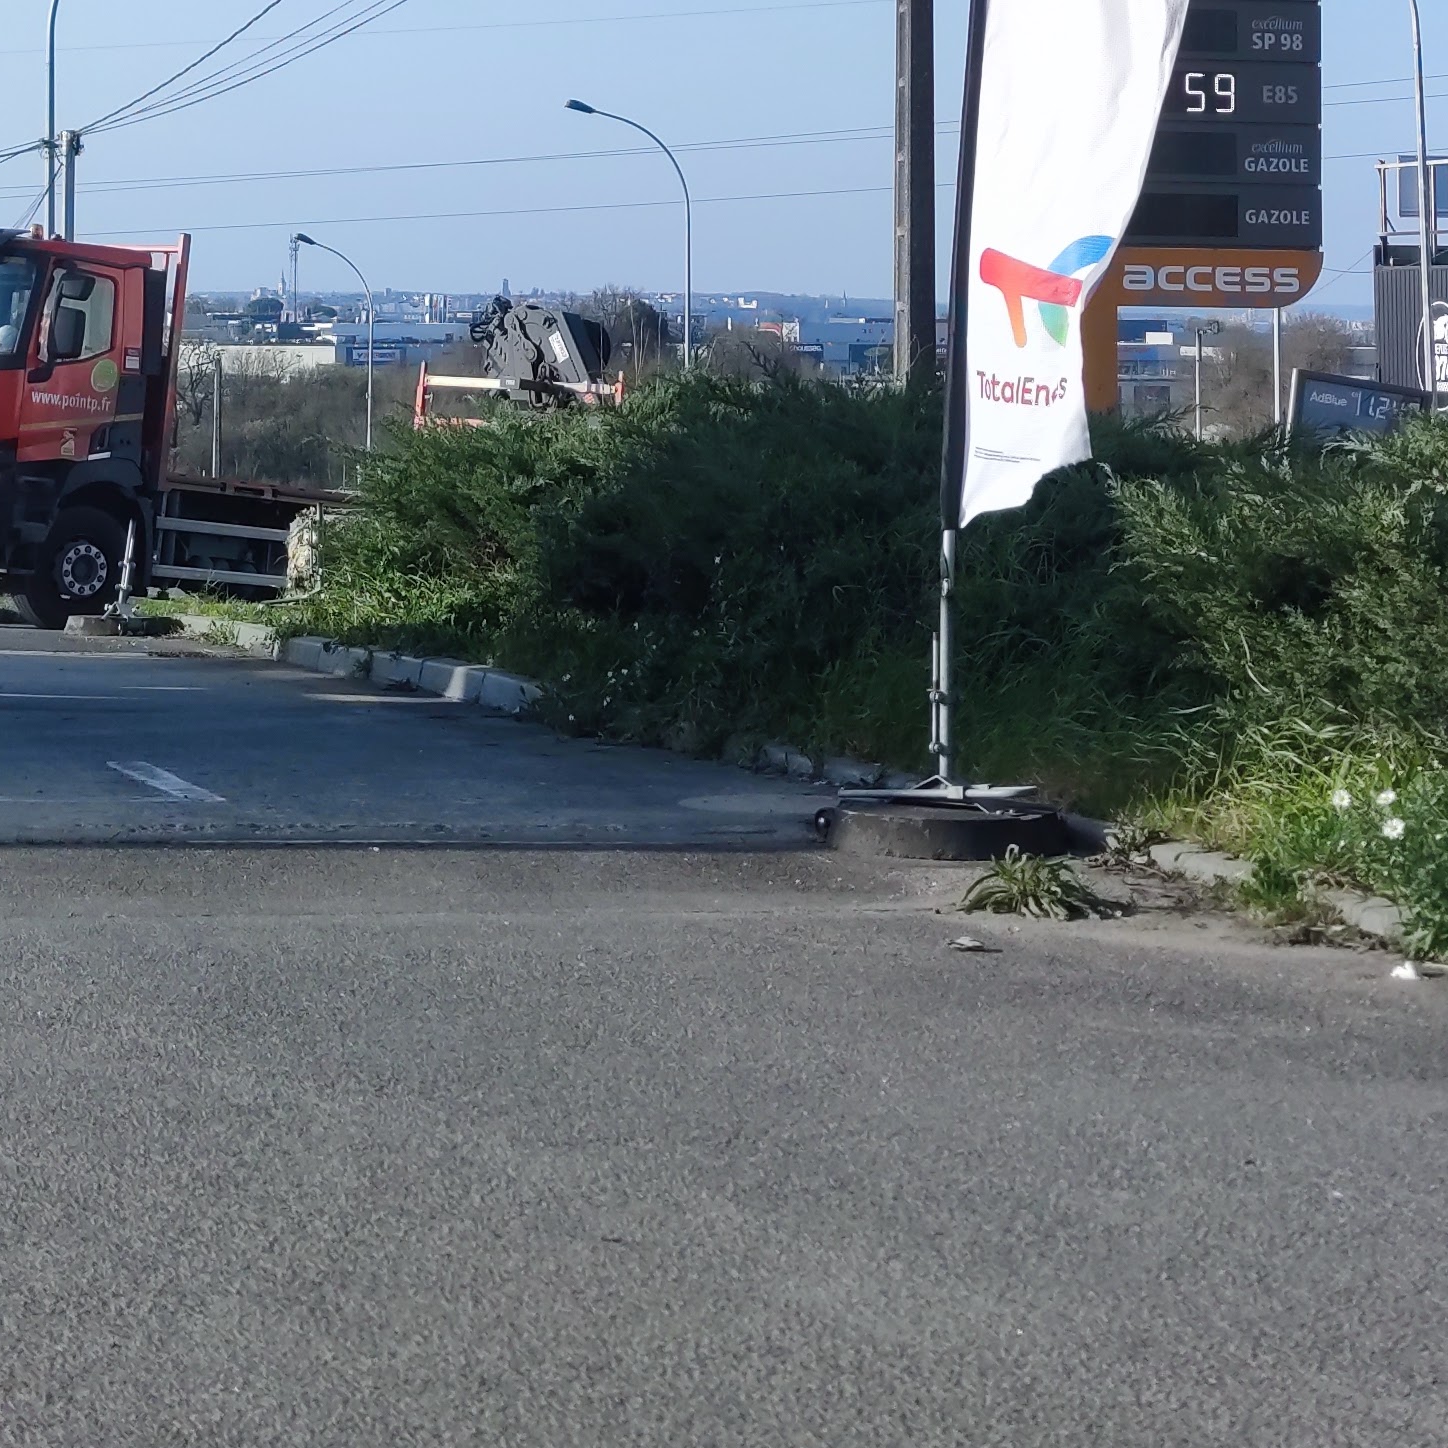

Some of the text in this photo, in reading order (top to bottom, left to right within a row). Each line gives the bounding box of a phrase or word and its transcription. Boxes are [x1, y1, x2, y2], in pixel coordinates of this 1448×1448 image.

[1252, 15, 1303, 30] excellium
[1252, 33, 1303, 51] SP 98
[1262, 85, 1299, 104] E85
[1244, 157, 1309, 173] GAZOLE
[1245, 209, 1310, 225] GAZOLE
[1310, 391, 1348, 407] AdBlue
